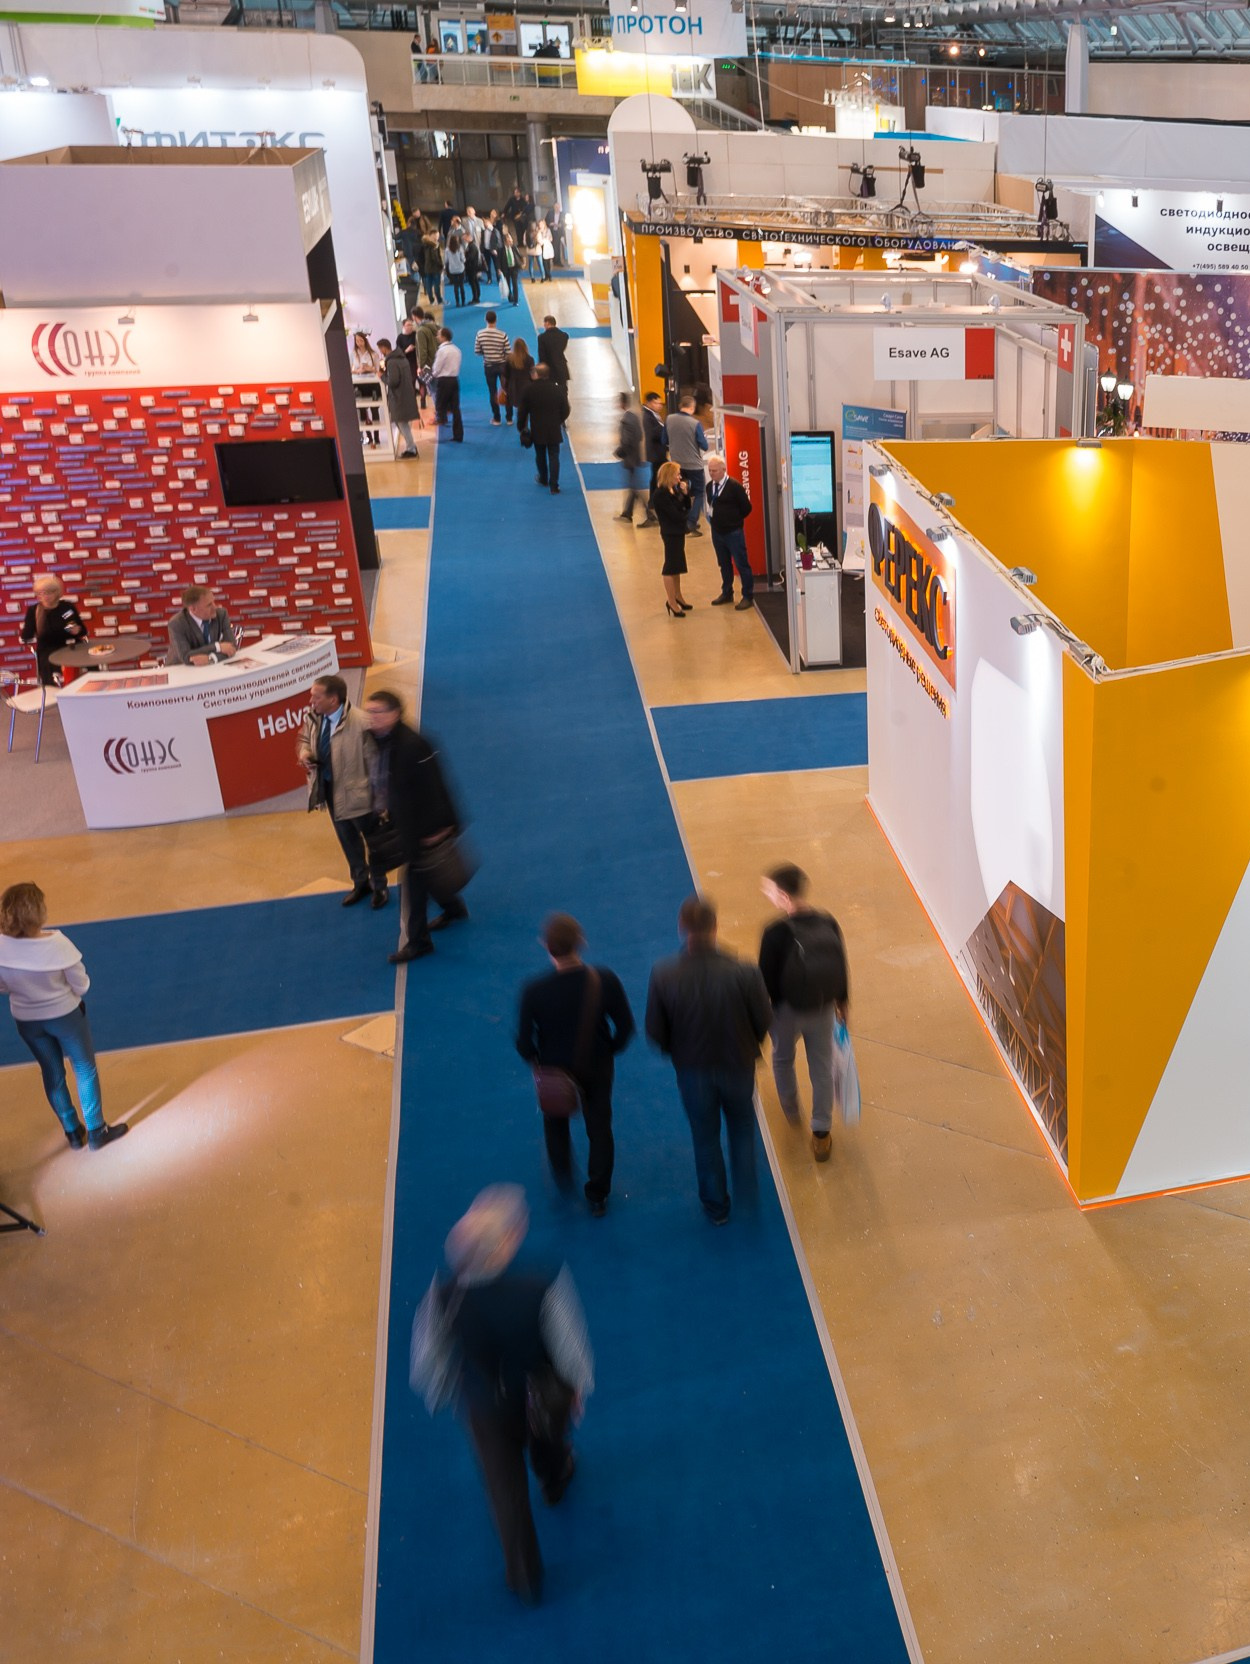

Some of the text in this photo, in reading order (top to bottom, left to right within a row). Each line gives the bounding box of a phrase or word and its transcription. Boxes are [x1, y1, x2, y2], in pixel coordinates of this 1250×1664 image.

[617, 15, 703, 36] ПРОТОН
[641, 224, 734, 240] ПРОИЗВОДСТВО
[742, 230, 867, 247] СВЕТОТЕХНИЧЕСКОГО
[888, 347, 950, 359] Esave AG
[738, 450, 750, 502] save AG
[868, 502, 949, 661] ФЕРЕКС
[126, 693, 195, 710] Компоненты
[196, 689, 216, 701] для
[218, 669, 290, 696] производителей
[203, 693, 248, 709] Системы
[249, 679, 298, 700] управления
[257, 706, 311, 740] Helva
